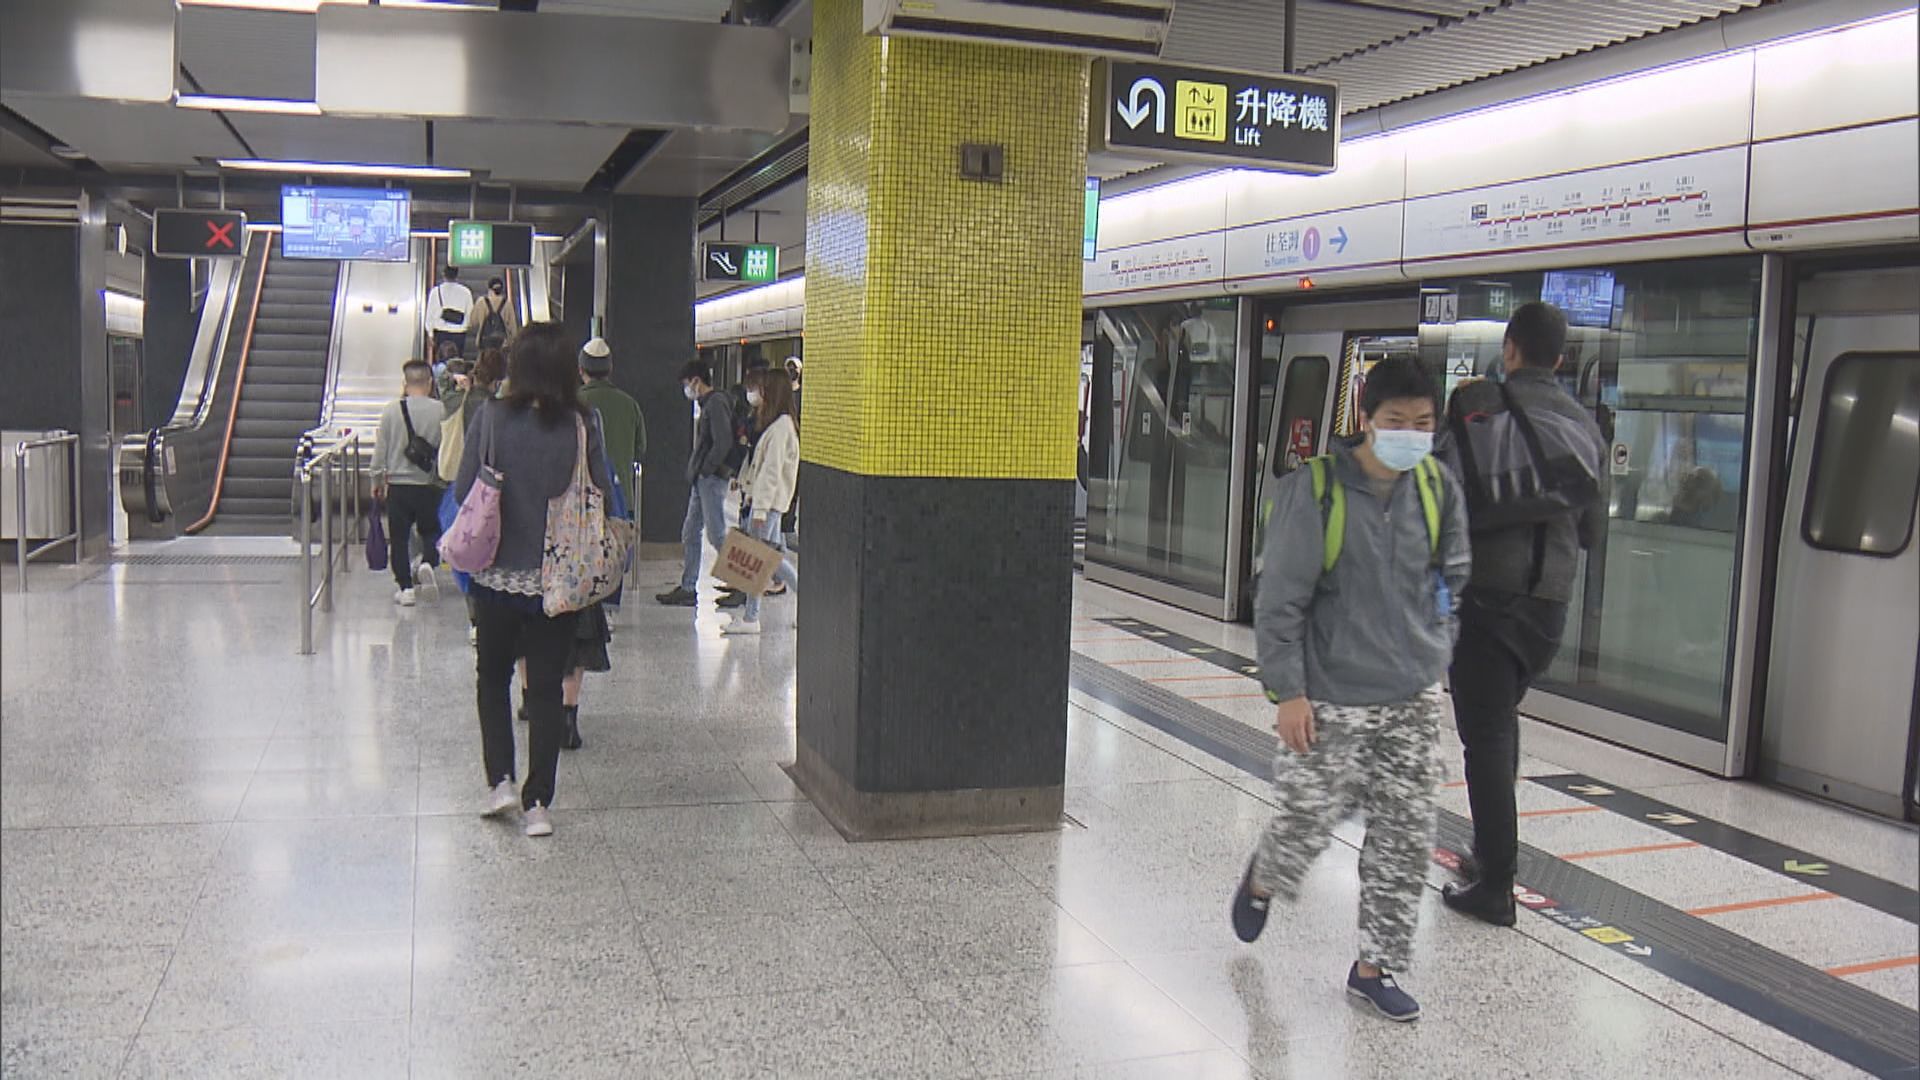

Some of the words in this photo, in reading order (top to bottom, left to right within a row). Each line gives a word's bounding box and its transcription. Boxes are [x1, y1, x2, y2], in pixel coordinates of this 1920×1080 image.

[1235, 87, 1329, 132] 升降機
[1235, 127, 1261, 146] Lift
[746, 265, 767, 278] EXIT
[727, 546, 764, 573] MUJI
